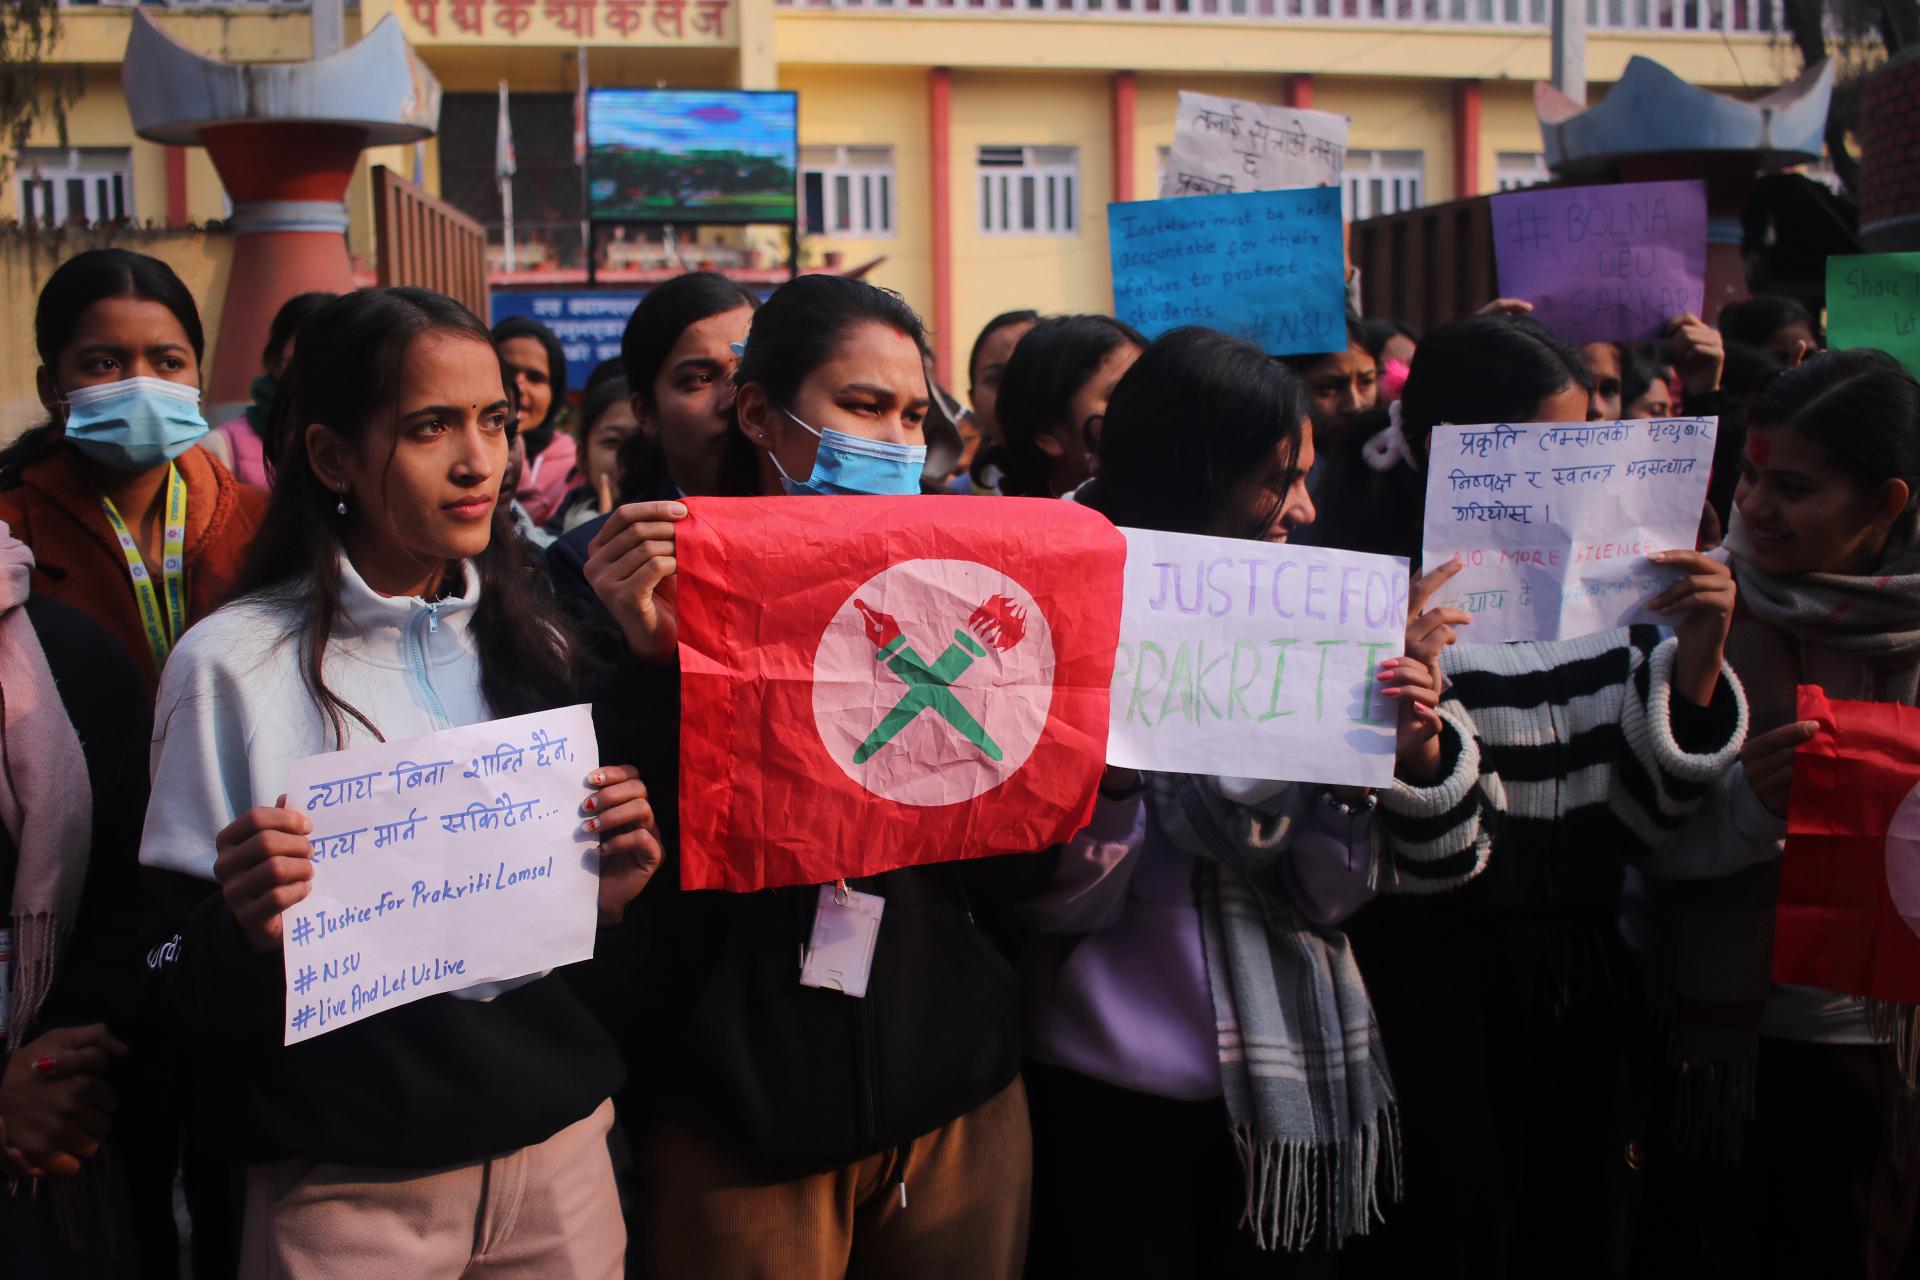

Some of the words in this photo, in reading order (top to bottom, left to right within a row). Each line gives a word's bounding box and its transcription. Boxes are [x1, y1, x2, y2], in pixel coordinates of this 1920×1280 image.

[1214, 210, 1253, 228] must
[1267, 207, 1286, 222] be
[1296, 202, 1331, 218] held
[1567, 198, 1671, 243] BOLNA
[1120, 238, 1217, 268] accountable
[1225, 239, 1257, 261] for
[1267, 233, 1321, 250] their
[1600, 246, 1657, 280] DEU
[1119, 280, 1182, 300] failure
[1190, 273, 1213, 288] to
[1222, 262, 1299, 285] protect
[1846, 265, 1901, 301] Share
[1130, 302, 1216, 327] students
[1500, 549, 1560, 567] MORE
[1111, 638, 1396, 727] PRAKRITI
[307, 772, 382, 811] न्याय
[389, 760, 454, 794] बिना
